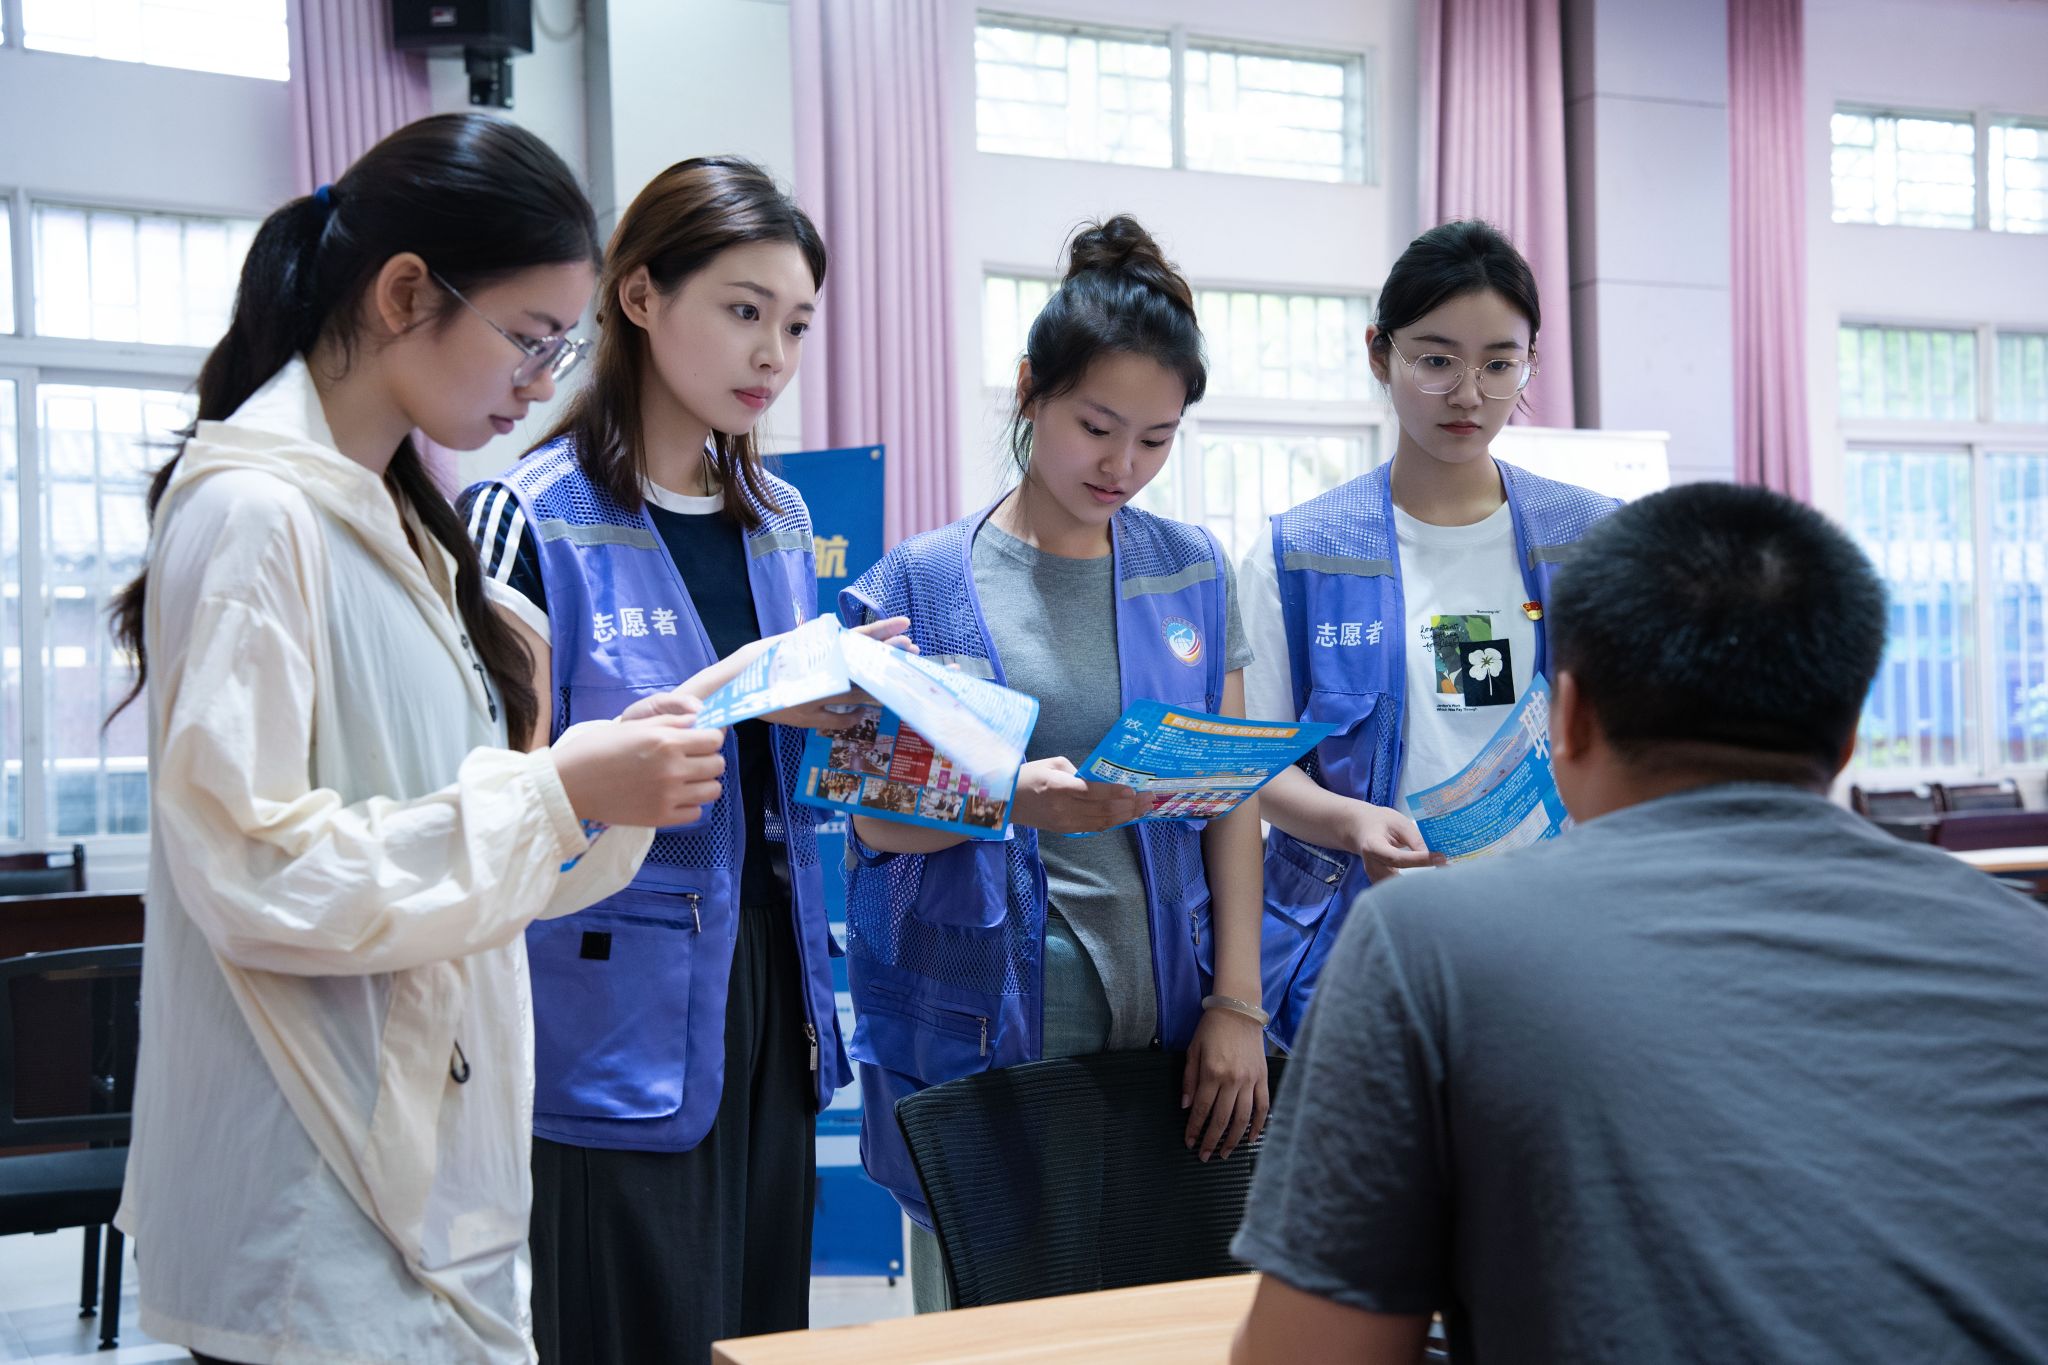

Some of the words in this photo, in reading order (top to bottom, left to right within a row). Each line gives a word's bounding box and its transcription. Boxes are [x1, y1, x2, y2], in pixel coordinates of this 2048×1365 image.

[814, 534, 849, 578] 航
[592, 607, 678, 643] 志愿者
[1315, 620, 1384, 648] 志愿者
